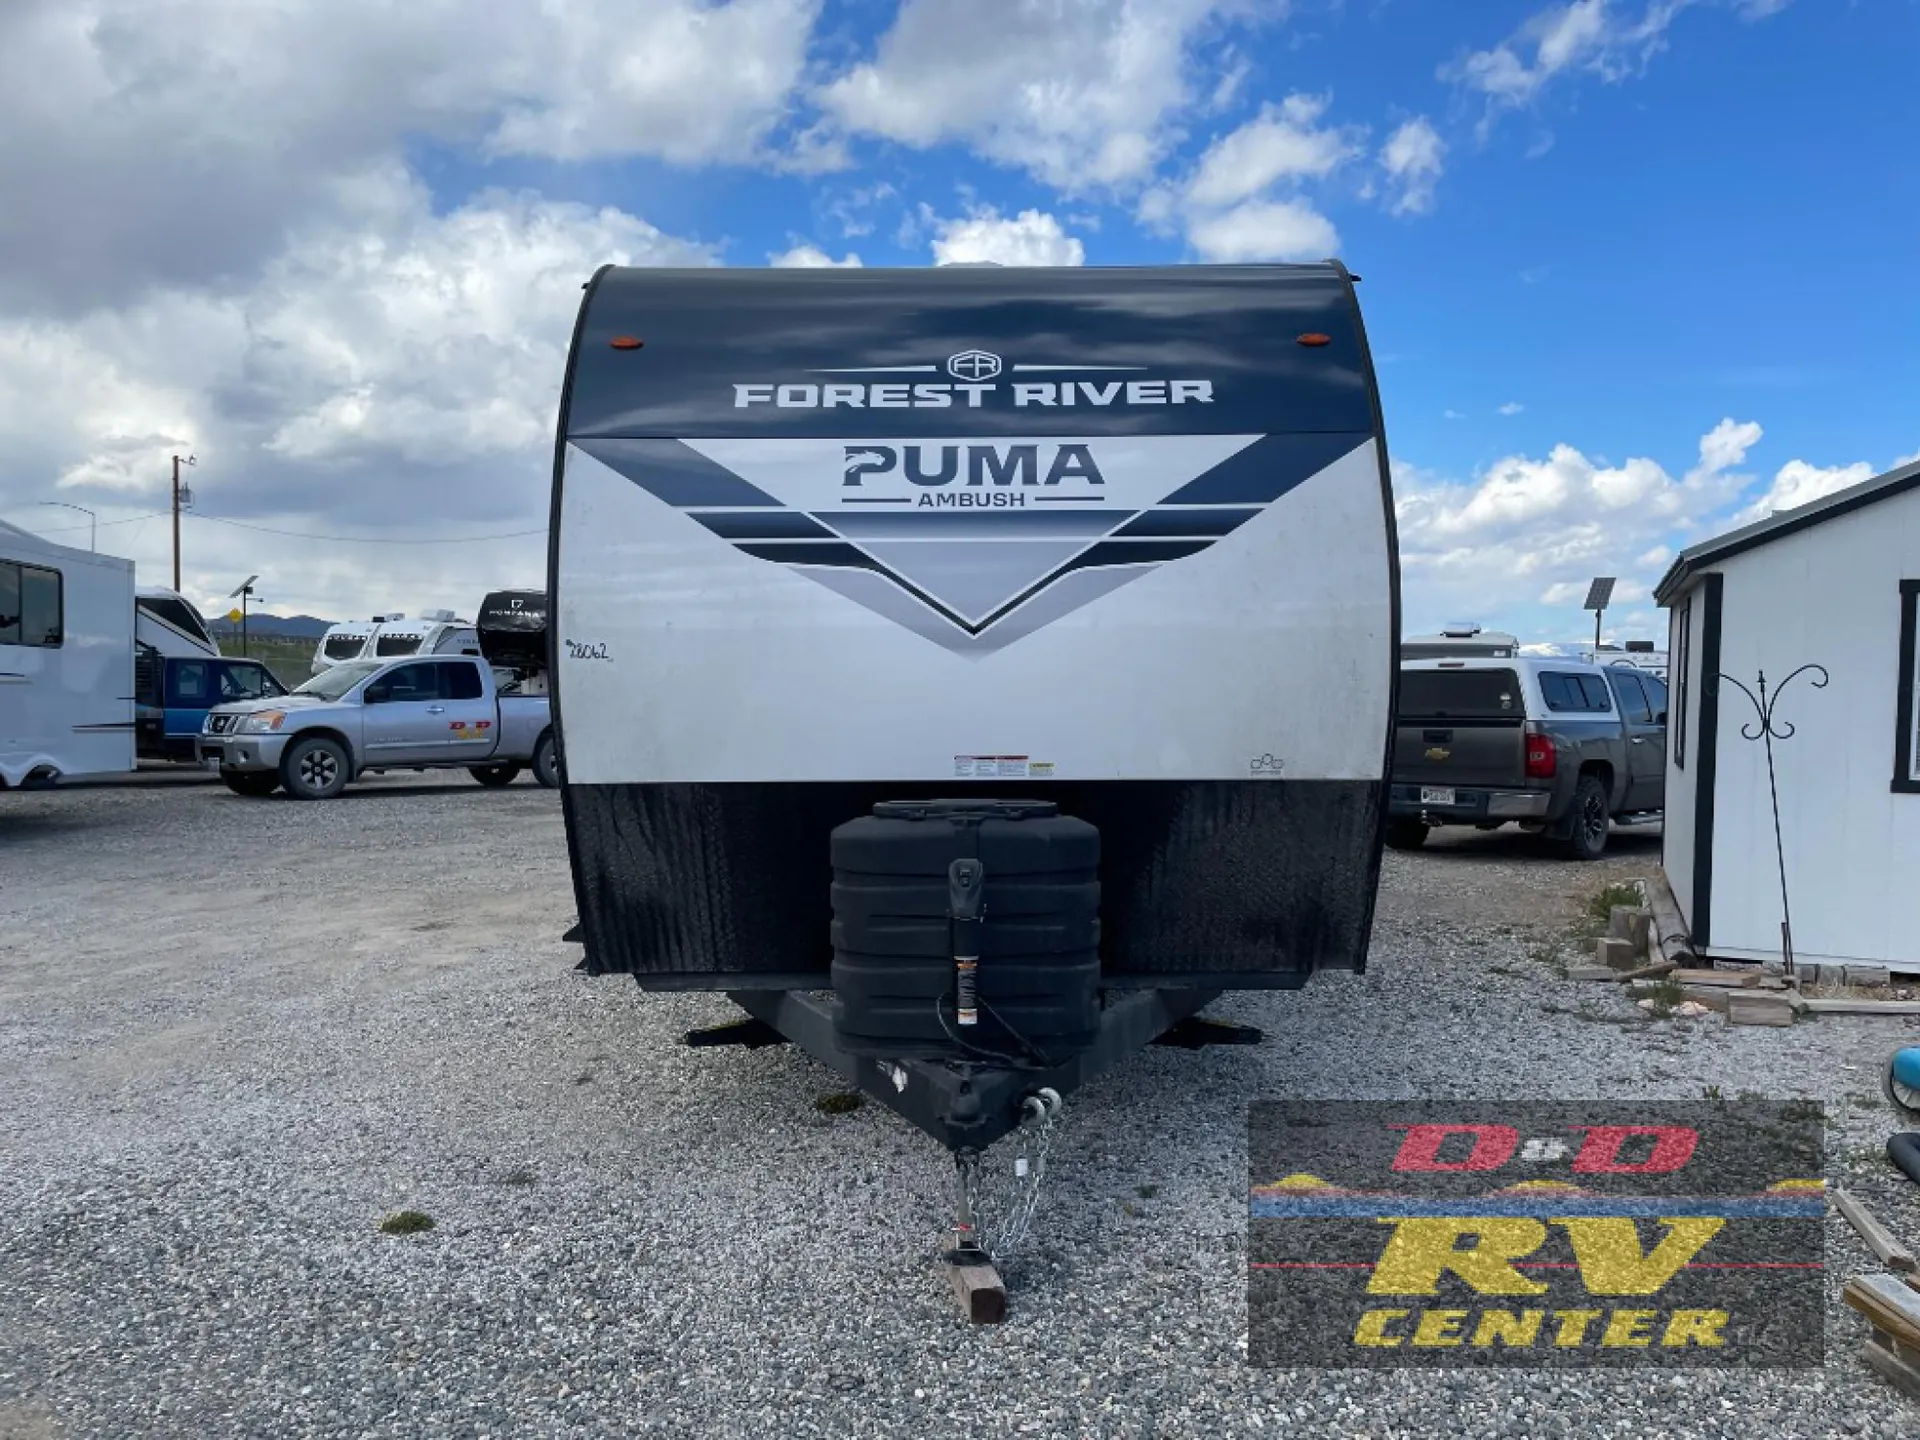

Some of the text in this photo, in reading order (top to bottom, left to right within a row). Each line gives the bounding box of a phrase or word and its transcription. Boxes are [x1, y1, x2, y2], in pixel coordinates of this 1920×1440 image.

[733, 380, 1215, 408] FOREST RIVER
[842, 444, 1106, 486] PUMA
[918, 492, 1026, 508] AMBUSH
